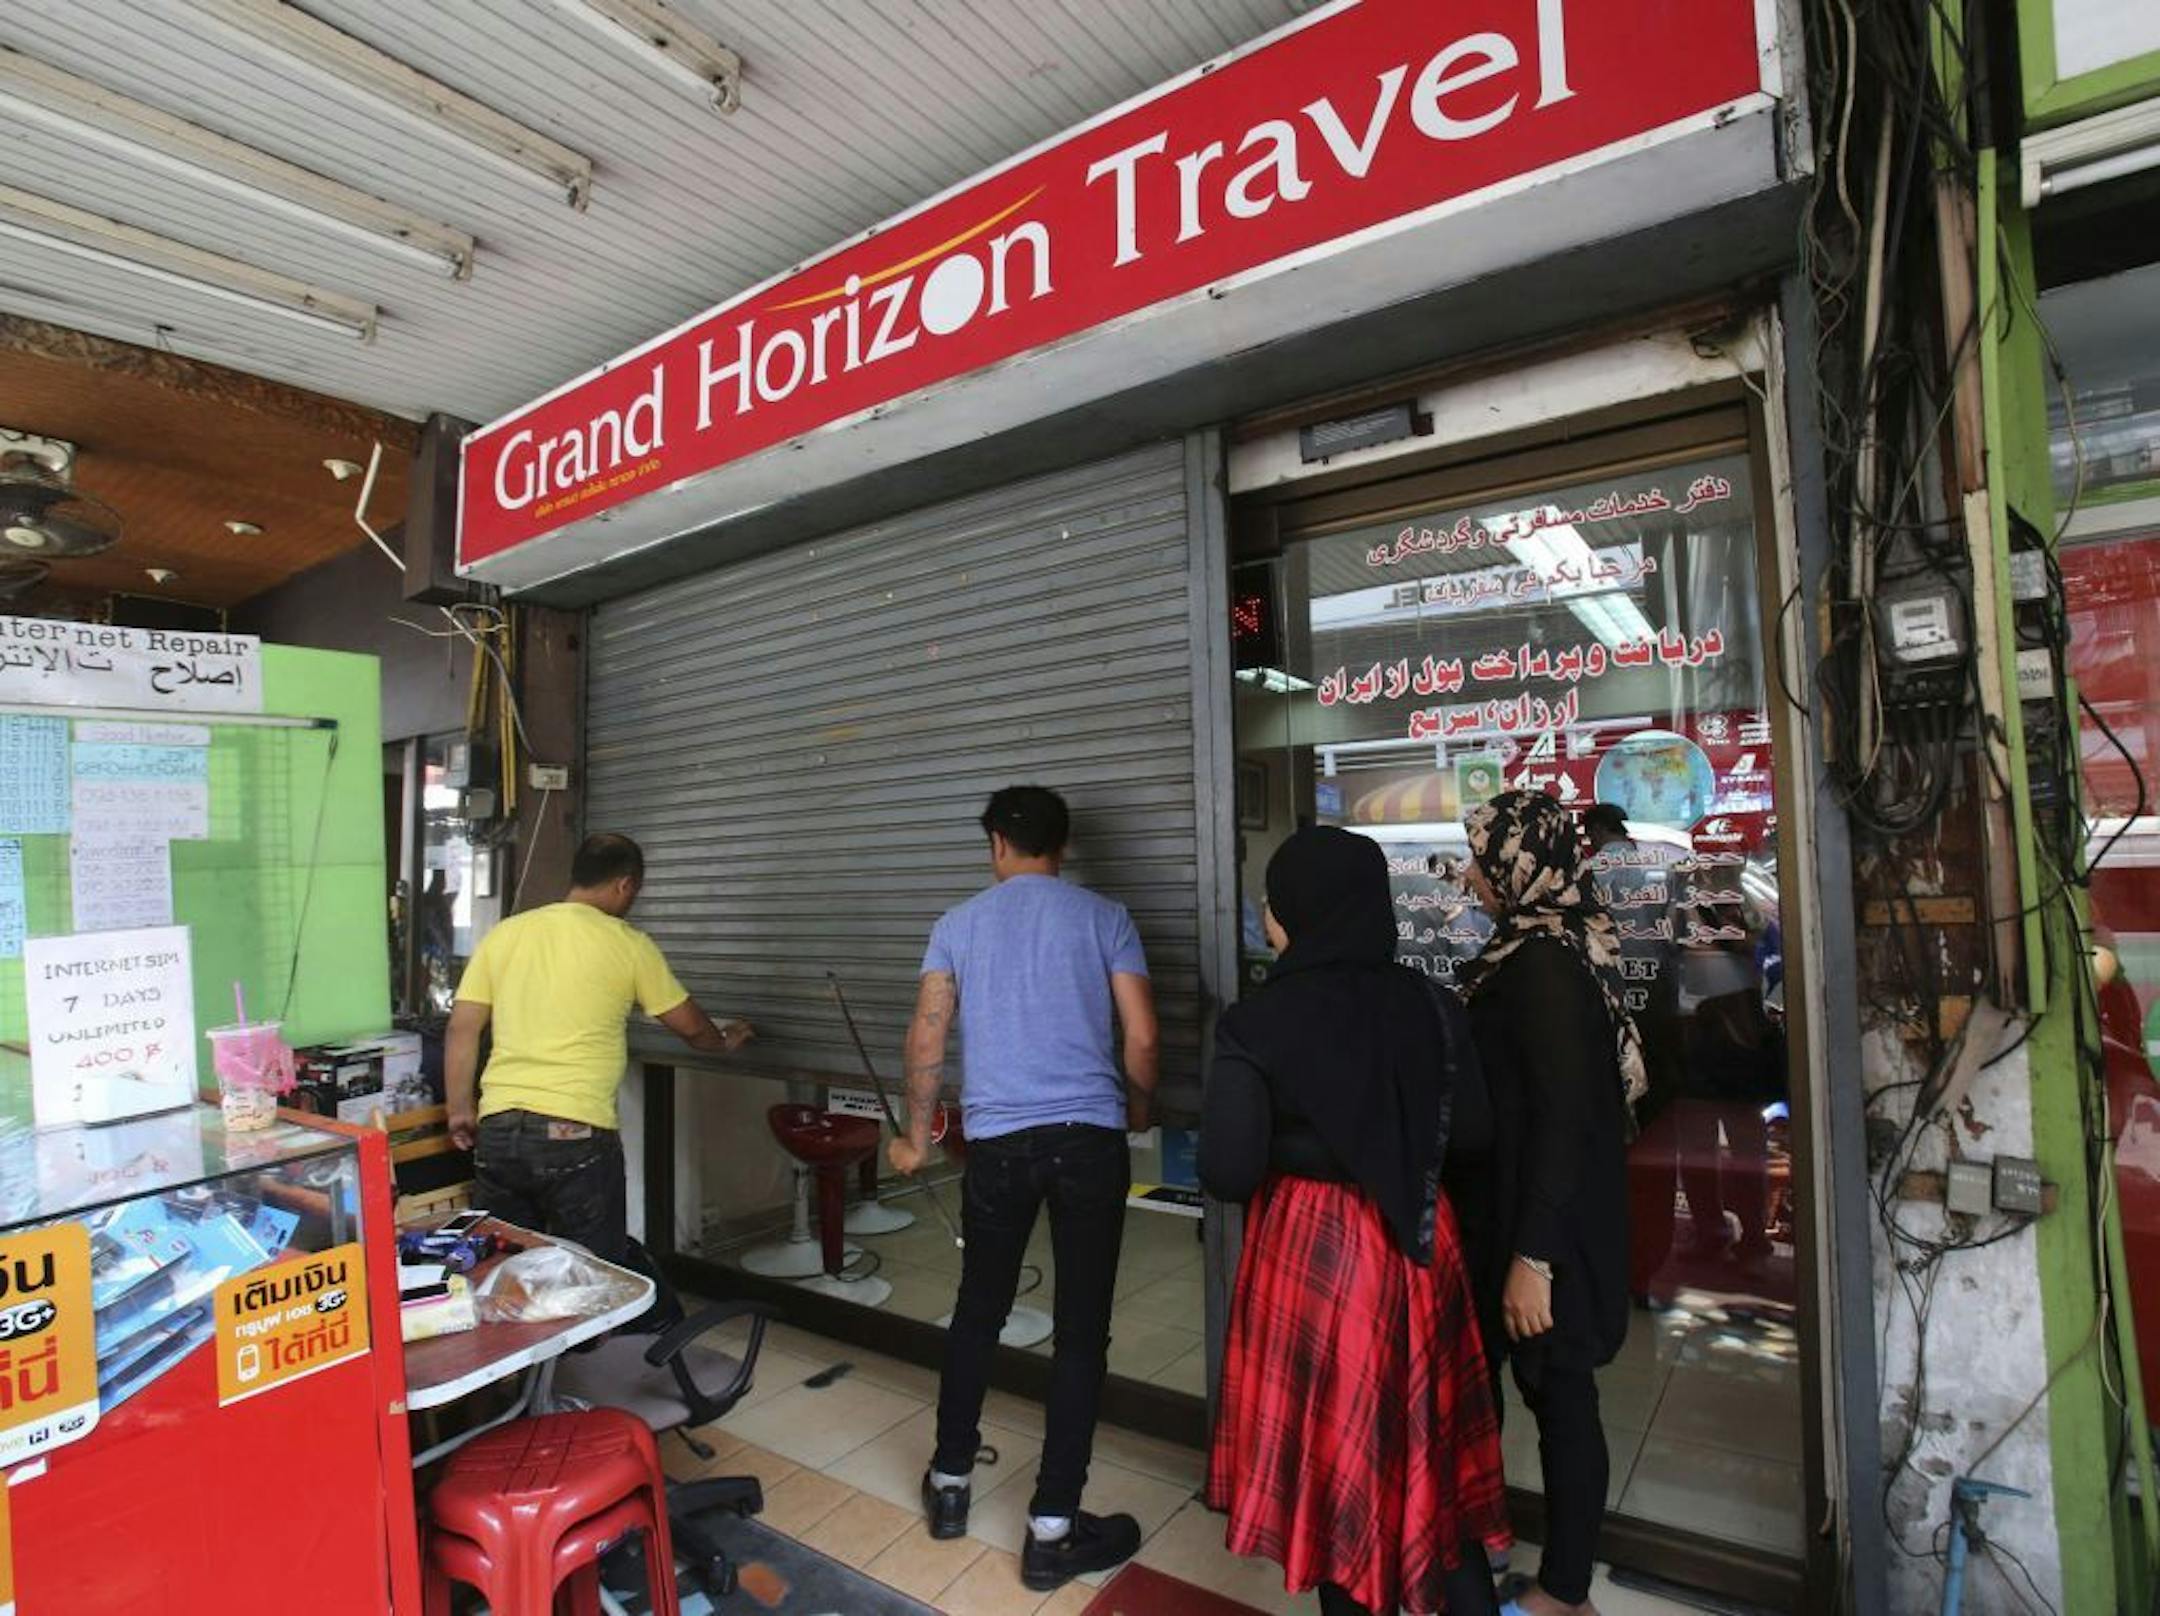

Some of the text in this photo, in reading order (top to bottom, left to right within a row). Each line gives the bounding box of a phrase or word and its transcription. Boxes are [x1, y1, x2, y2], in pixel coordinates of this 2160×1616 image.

[495, 0, 1577, 510] Grand Horizon Travel
[147, 630, 248, 657] Repair
[44, 952, 180, 980] INTERNET SIM
[63, 986, 162, 1013] 7 DAYS
[48, 1016, 166, 1044] UNLIMITED
[75, 1048, 134, 1068] 400
[234, 1261, 347, 1315] เติมเงิน
